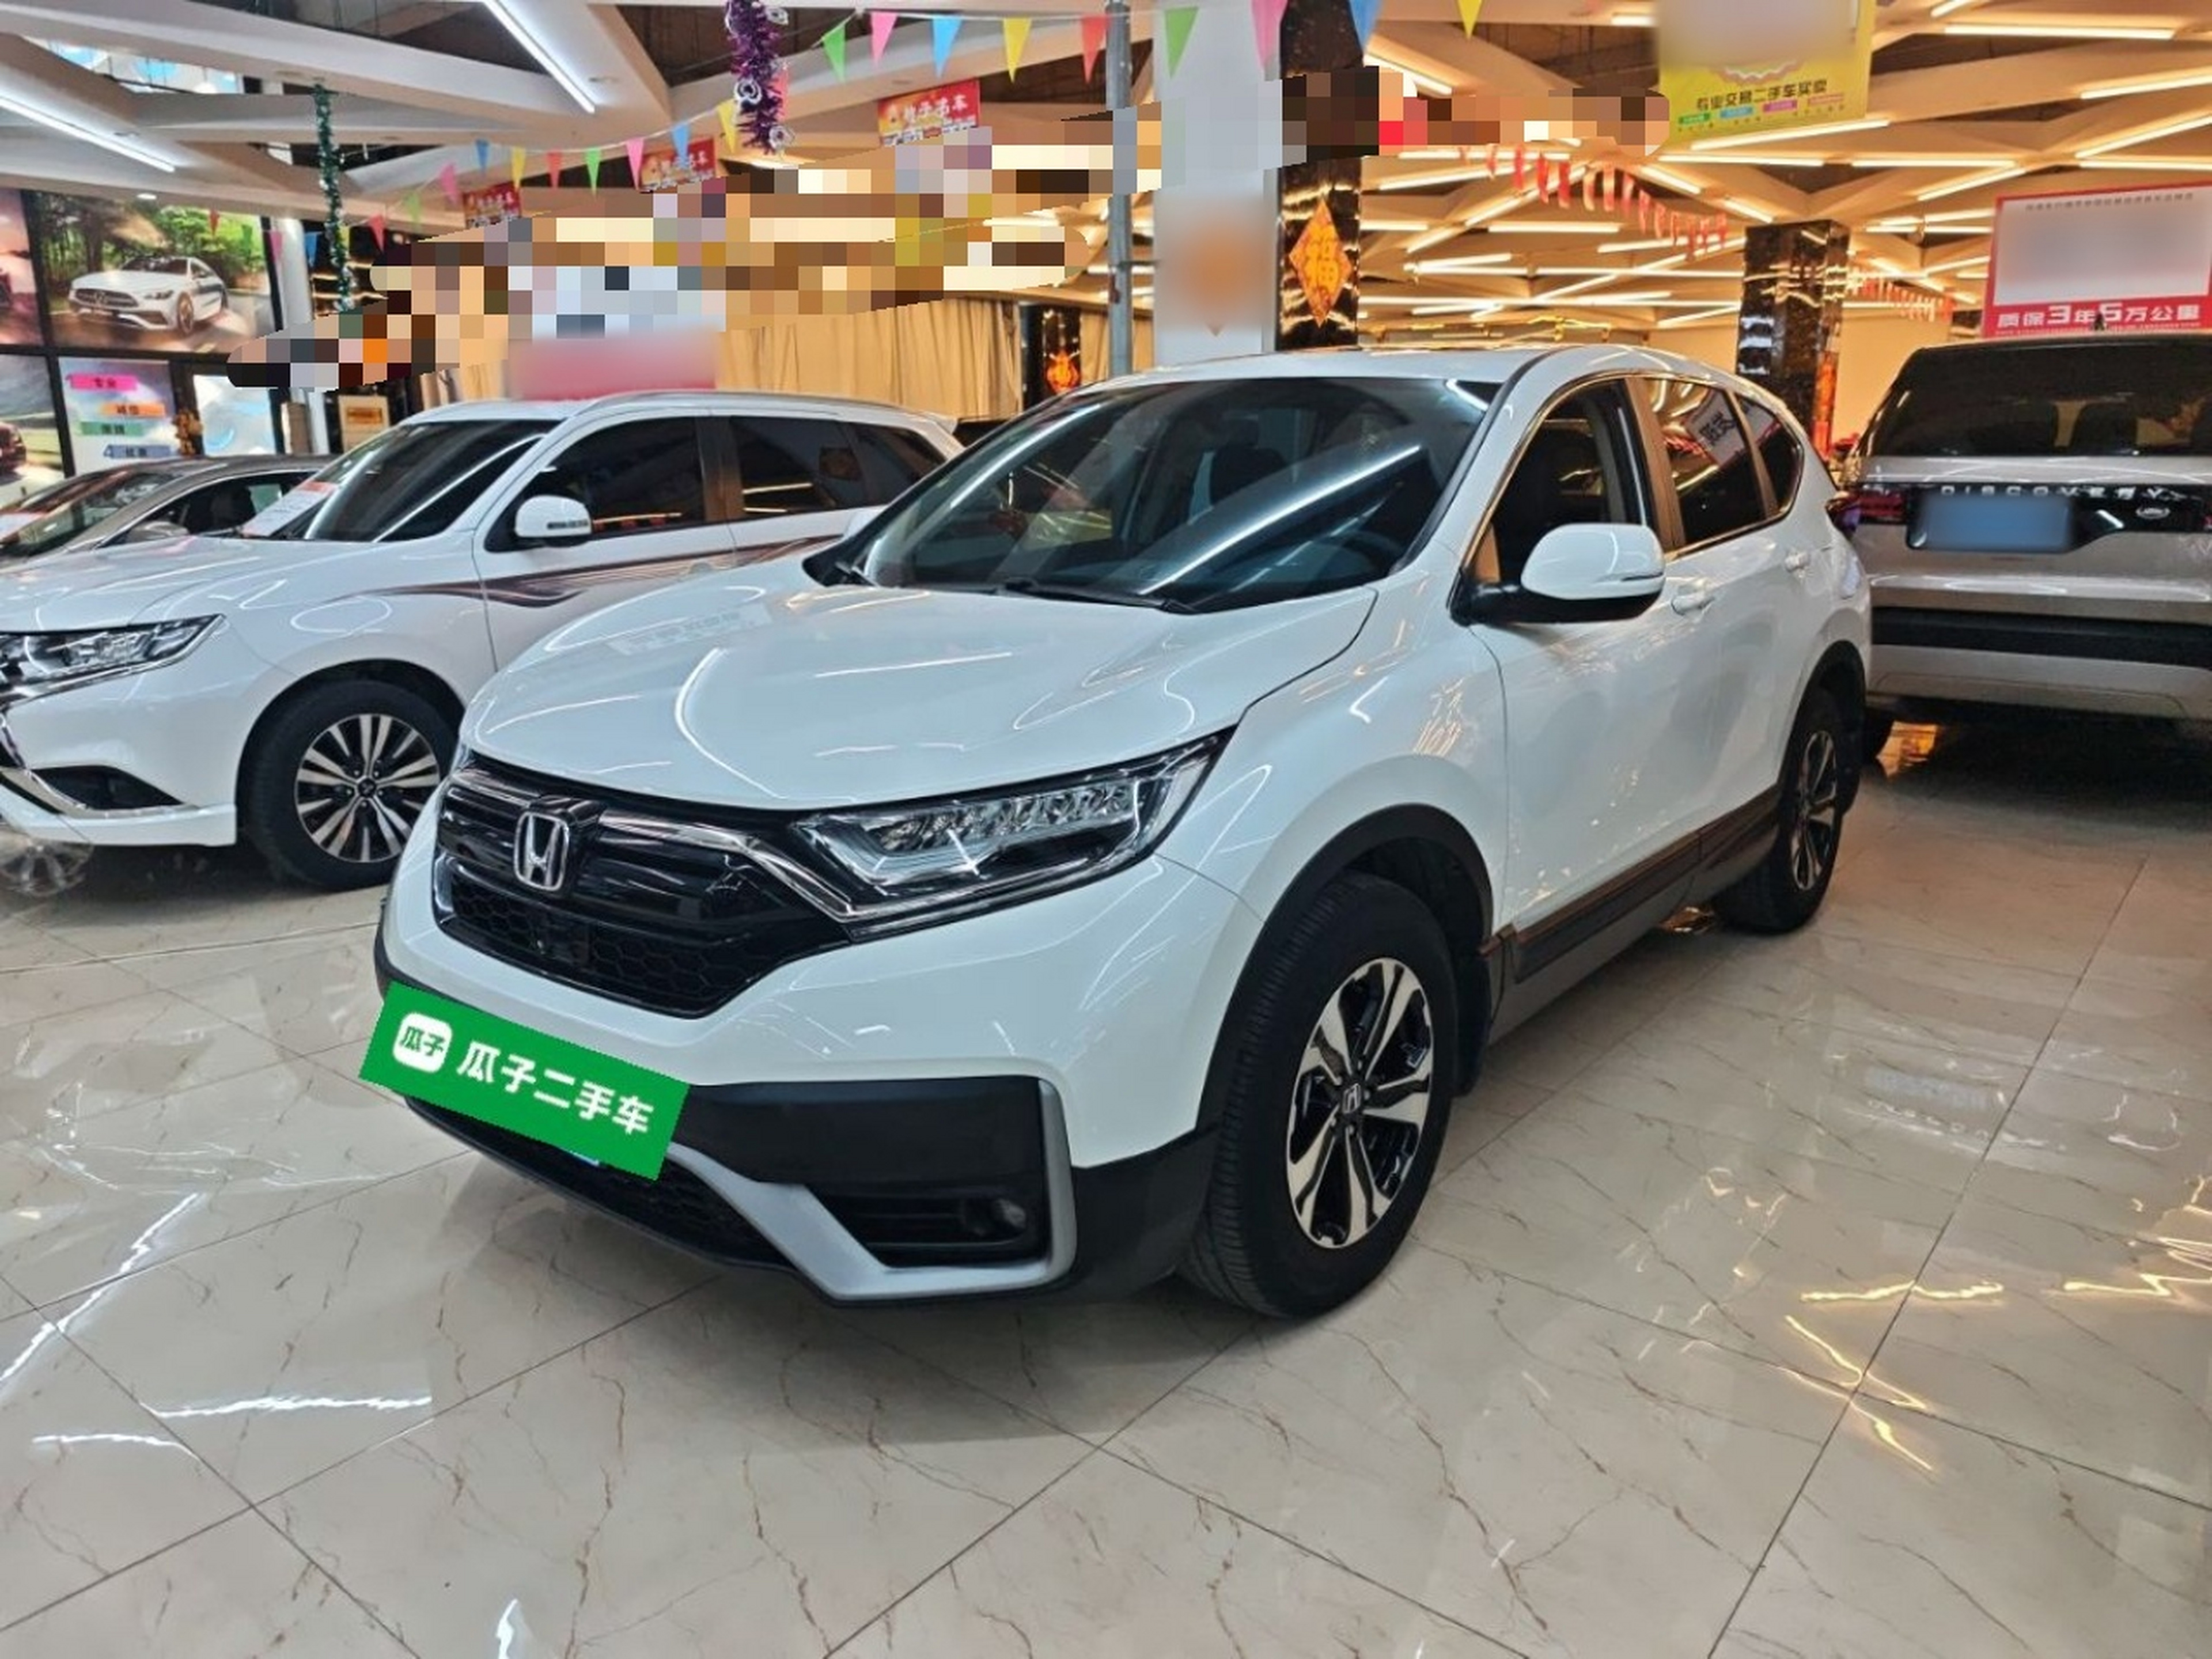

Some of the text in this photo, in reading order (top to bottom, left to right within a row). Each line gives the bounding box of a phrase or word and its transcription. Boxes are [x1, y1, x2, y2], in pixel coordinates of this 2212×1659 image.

[1997, 302, 2200, 329] 质保3年5万公里
